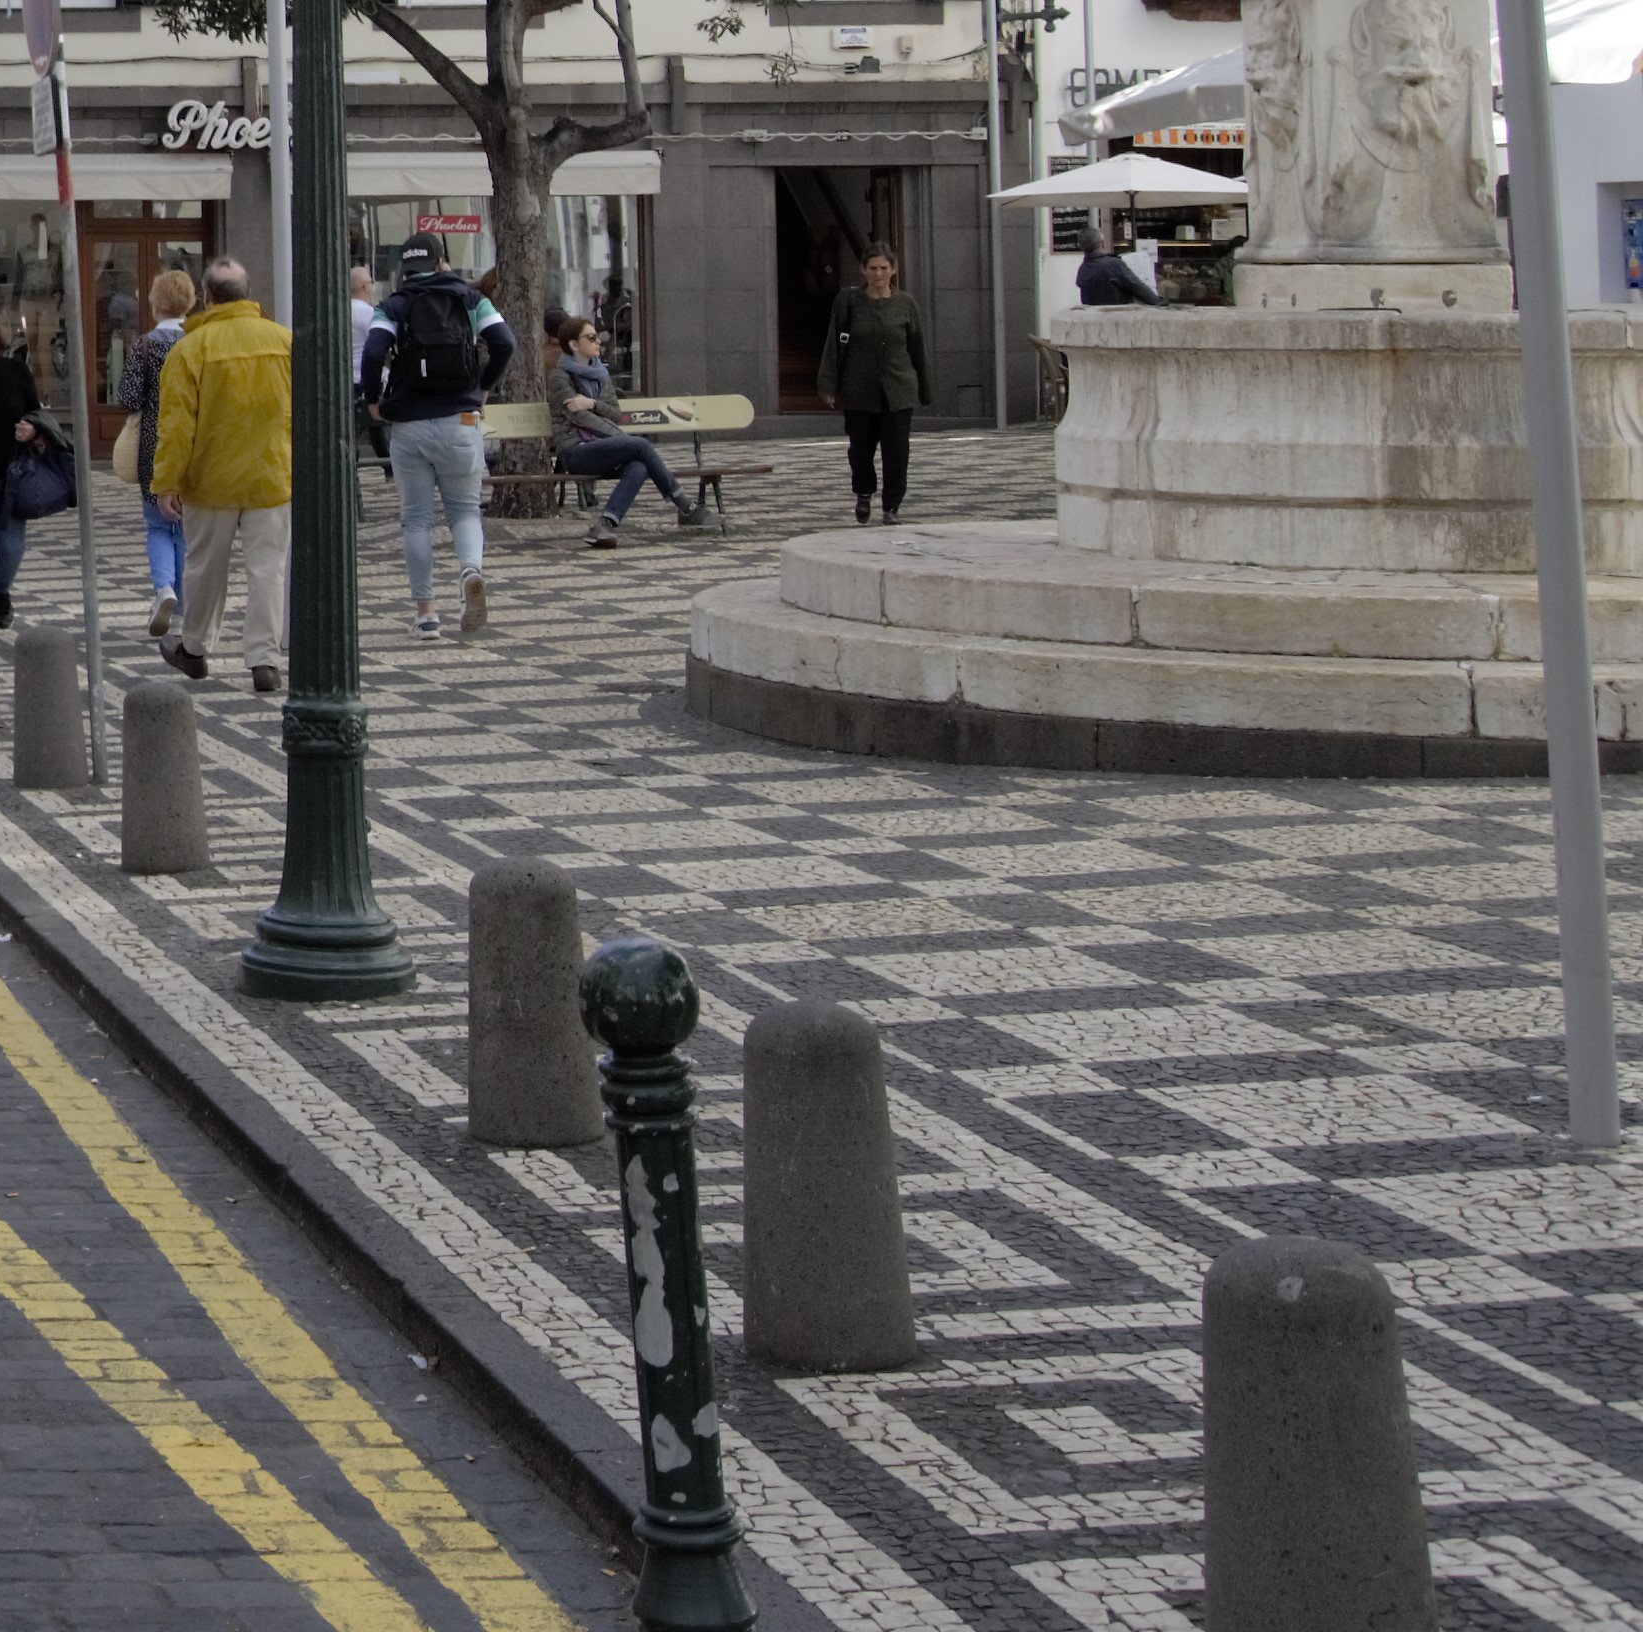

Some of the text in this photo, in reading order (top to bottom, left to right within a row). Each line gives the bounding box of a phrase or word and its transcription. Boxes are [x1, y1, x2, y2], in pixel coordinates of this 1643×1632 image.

[162, 100, 272, 150] Phoe
[420, 217, 478, 231] Phoebus
[403, 249, 428, 259] adidas
